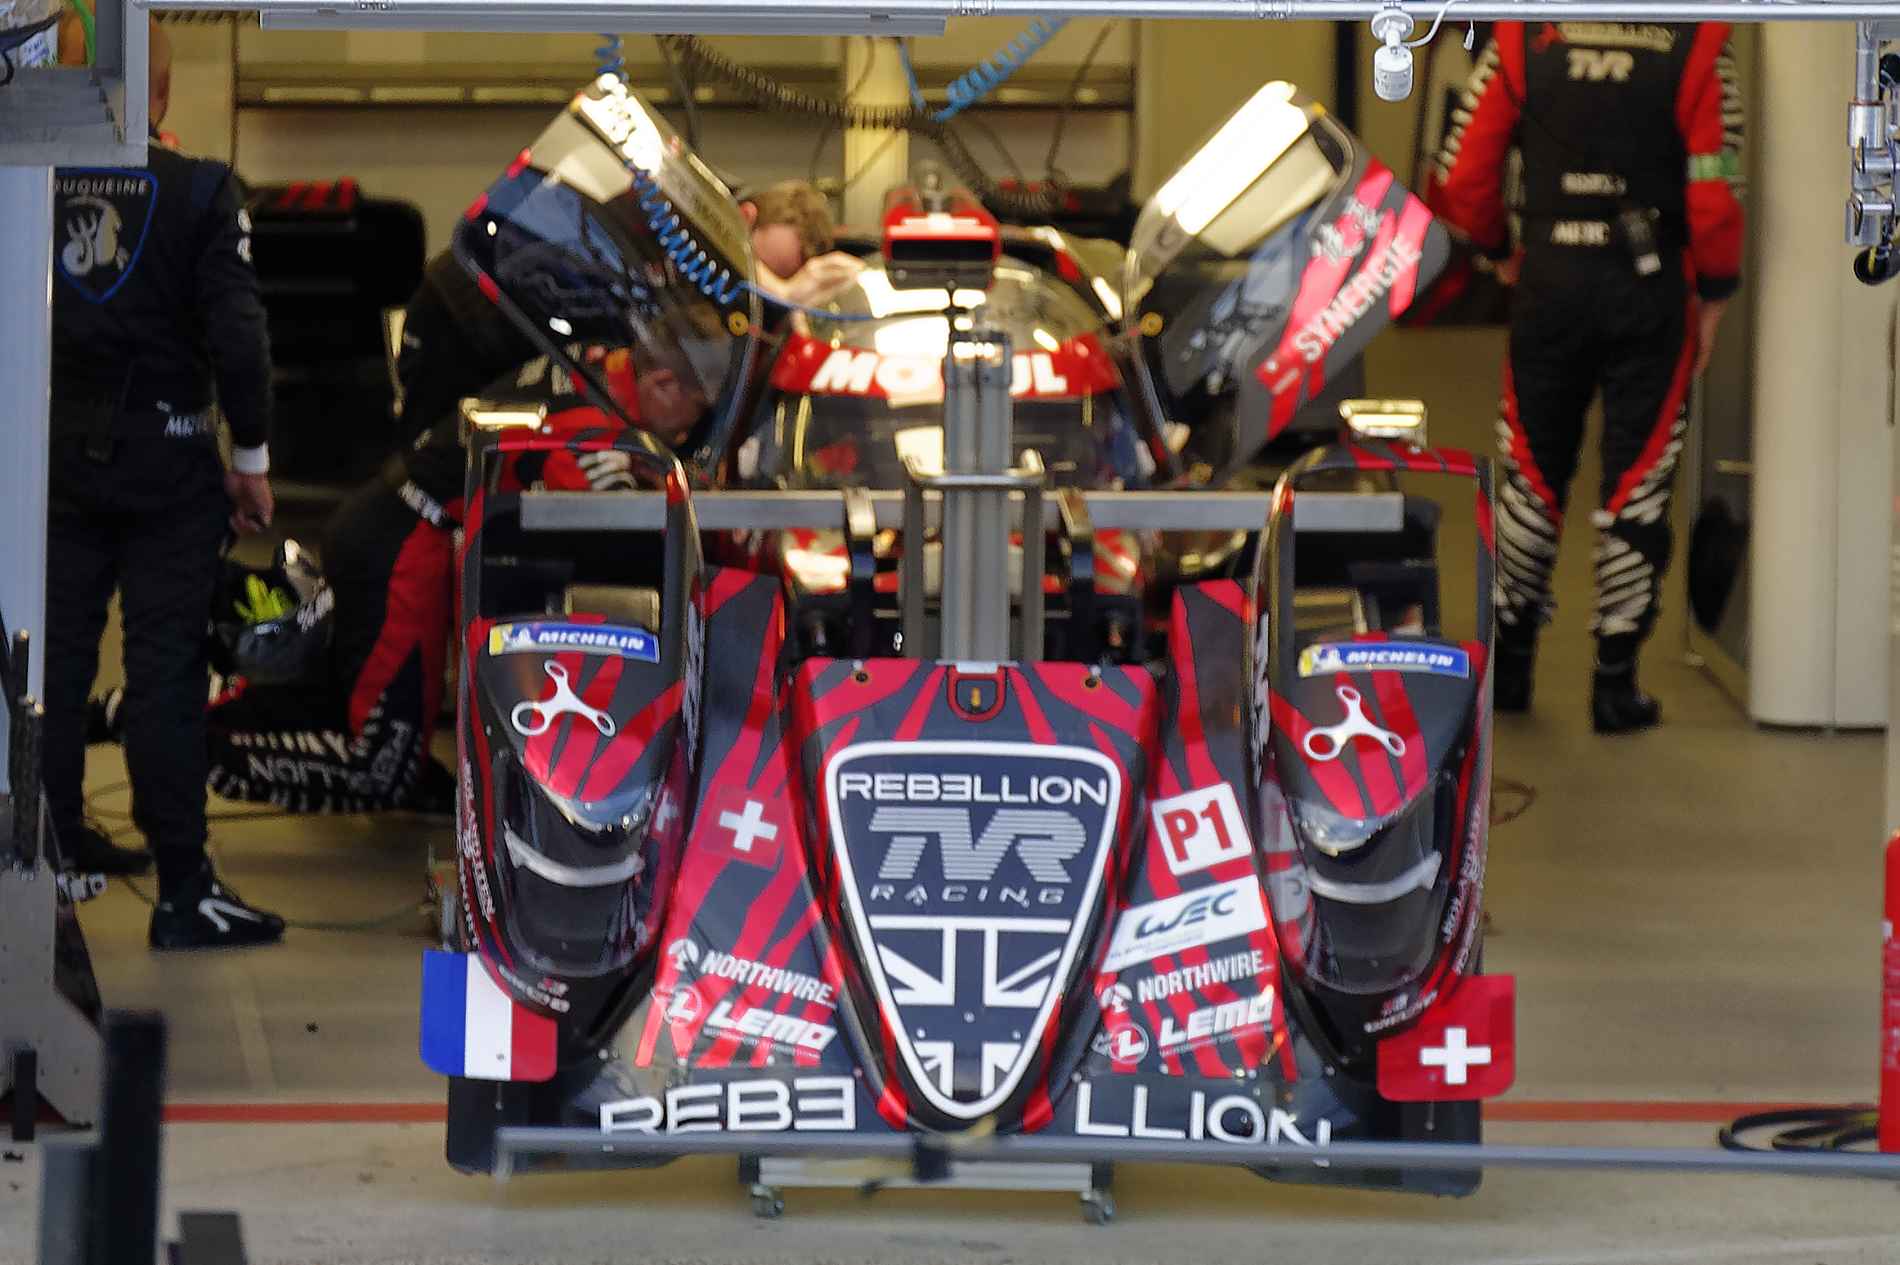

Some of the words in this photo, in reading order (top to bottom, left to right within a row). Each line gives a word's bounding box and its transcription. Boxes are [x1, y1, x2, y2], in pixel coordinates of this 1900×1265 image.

[1295, 232, 1422, 362] SYNERGIE
[810, 349, 1067, 395] MOUL
[537, 630, 645, 650] MICHELIN
[1345, 650, 1454, 667] MICHELIN
[838, 772, 1108, 805] REBELLION
[868, 806, 1087, 884] TVR
[1162, 799, 1233, 863] P1
[869, 883, 1065, 906] RACING
[1134, 888, 1238, 940] WEC
[701, 950, 833, 1004] NORTHWIRE
[1137, 950, 1265, 1004] NORTHWIRE
[705, 1000, 838, 1051] LEMO
[1159, 986, 1275, 1047] LEMO
